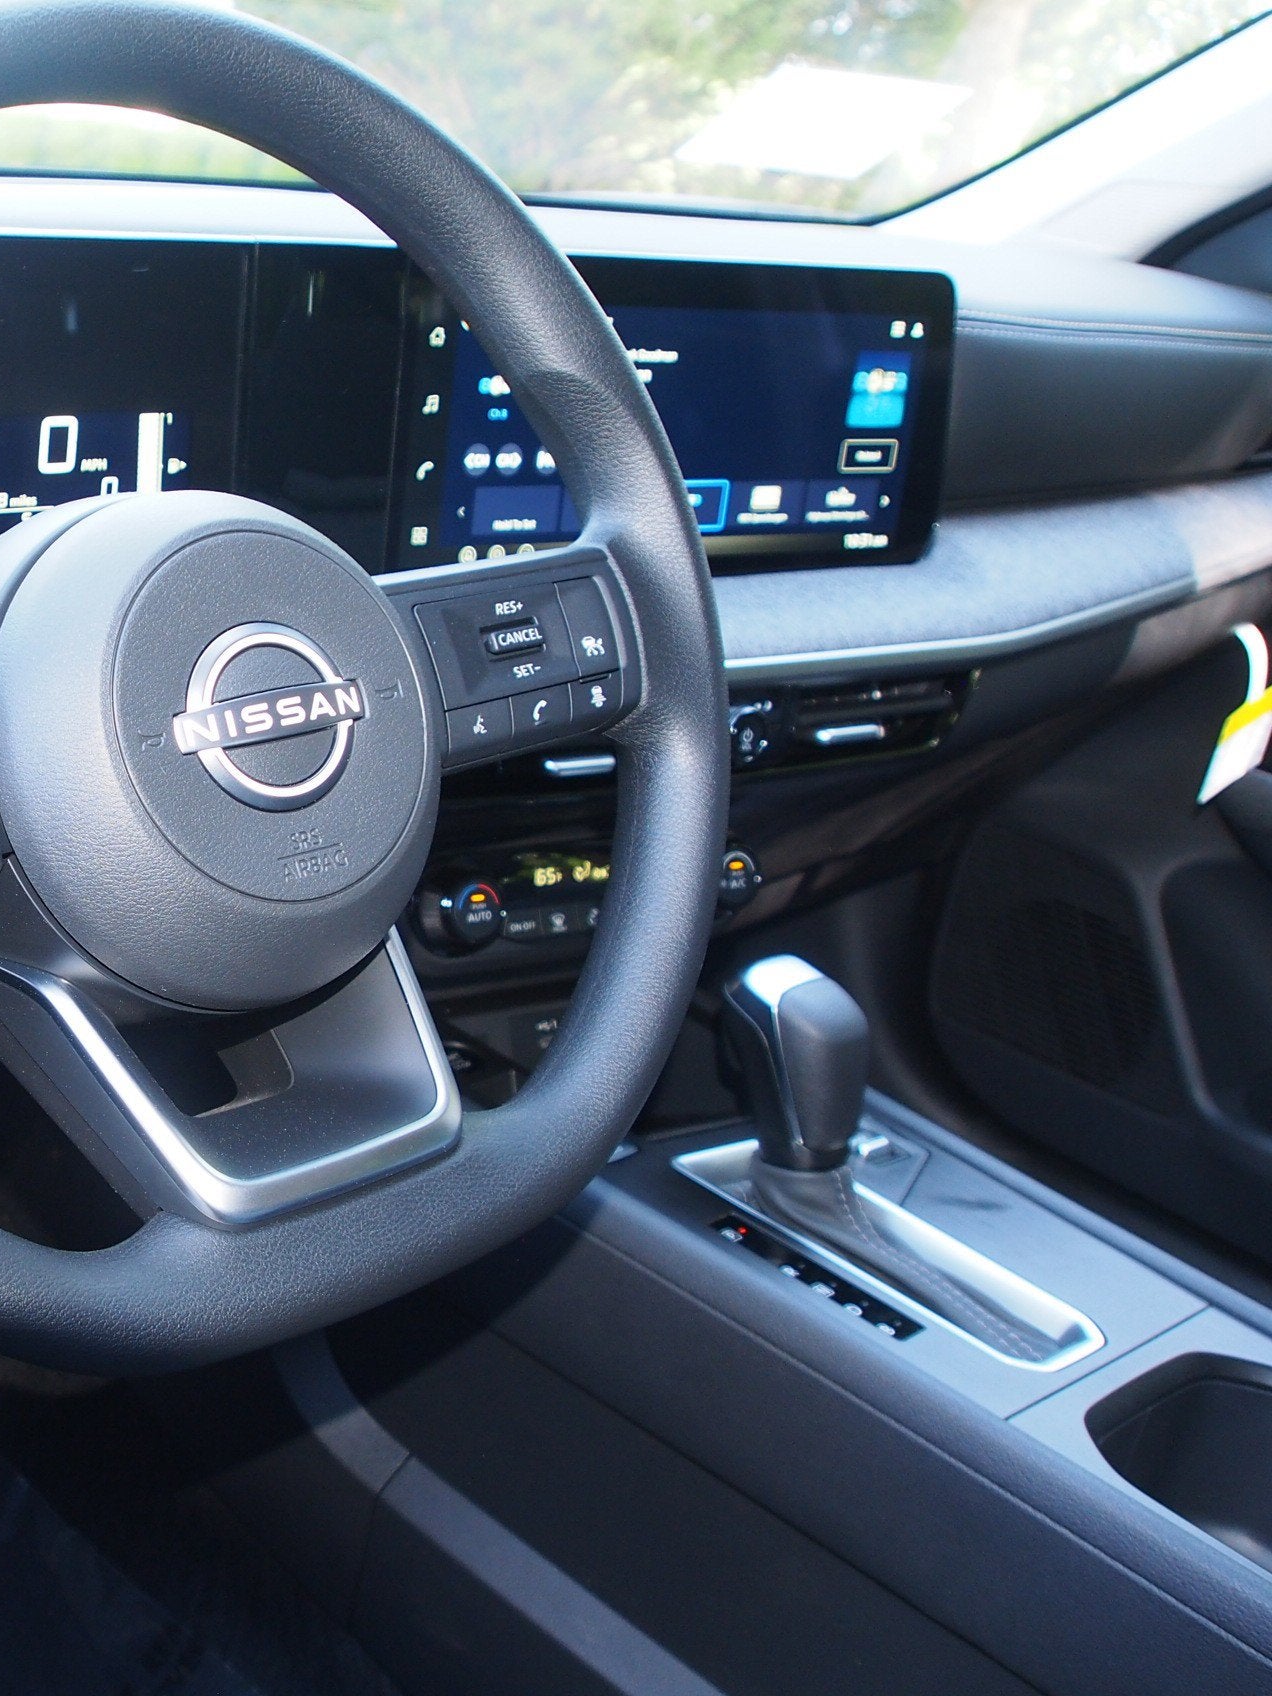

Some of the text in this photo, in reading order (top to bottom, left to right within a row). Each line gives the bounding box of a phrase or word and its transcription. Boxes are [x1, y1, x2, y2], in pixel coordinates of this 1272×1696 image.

[38, 415, 108, 475] 0 MPH
[9, 494, 38, 507] miles
[495, 600, 524, 616] RES+
[497, 628, 543, 647] CANCEL
[181, 686, 362, 748] NISSAN
[290, 828, 324, 851] SRS
[282, 849, 350, 882] AIRBAG
[468, 911, 492, 923] AUTO
